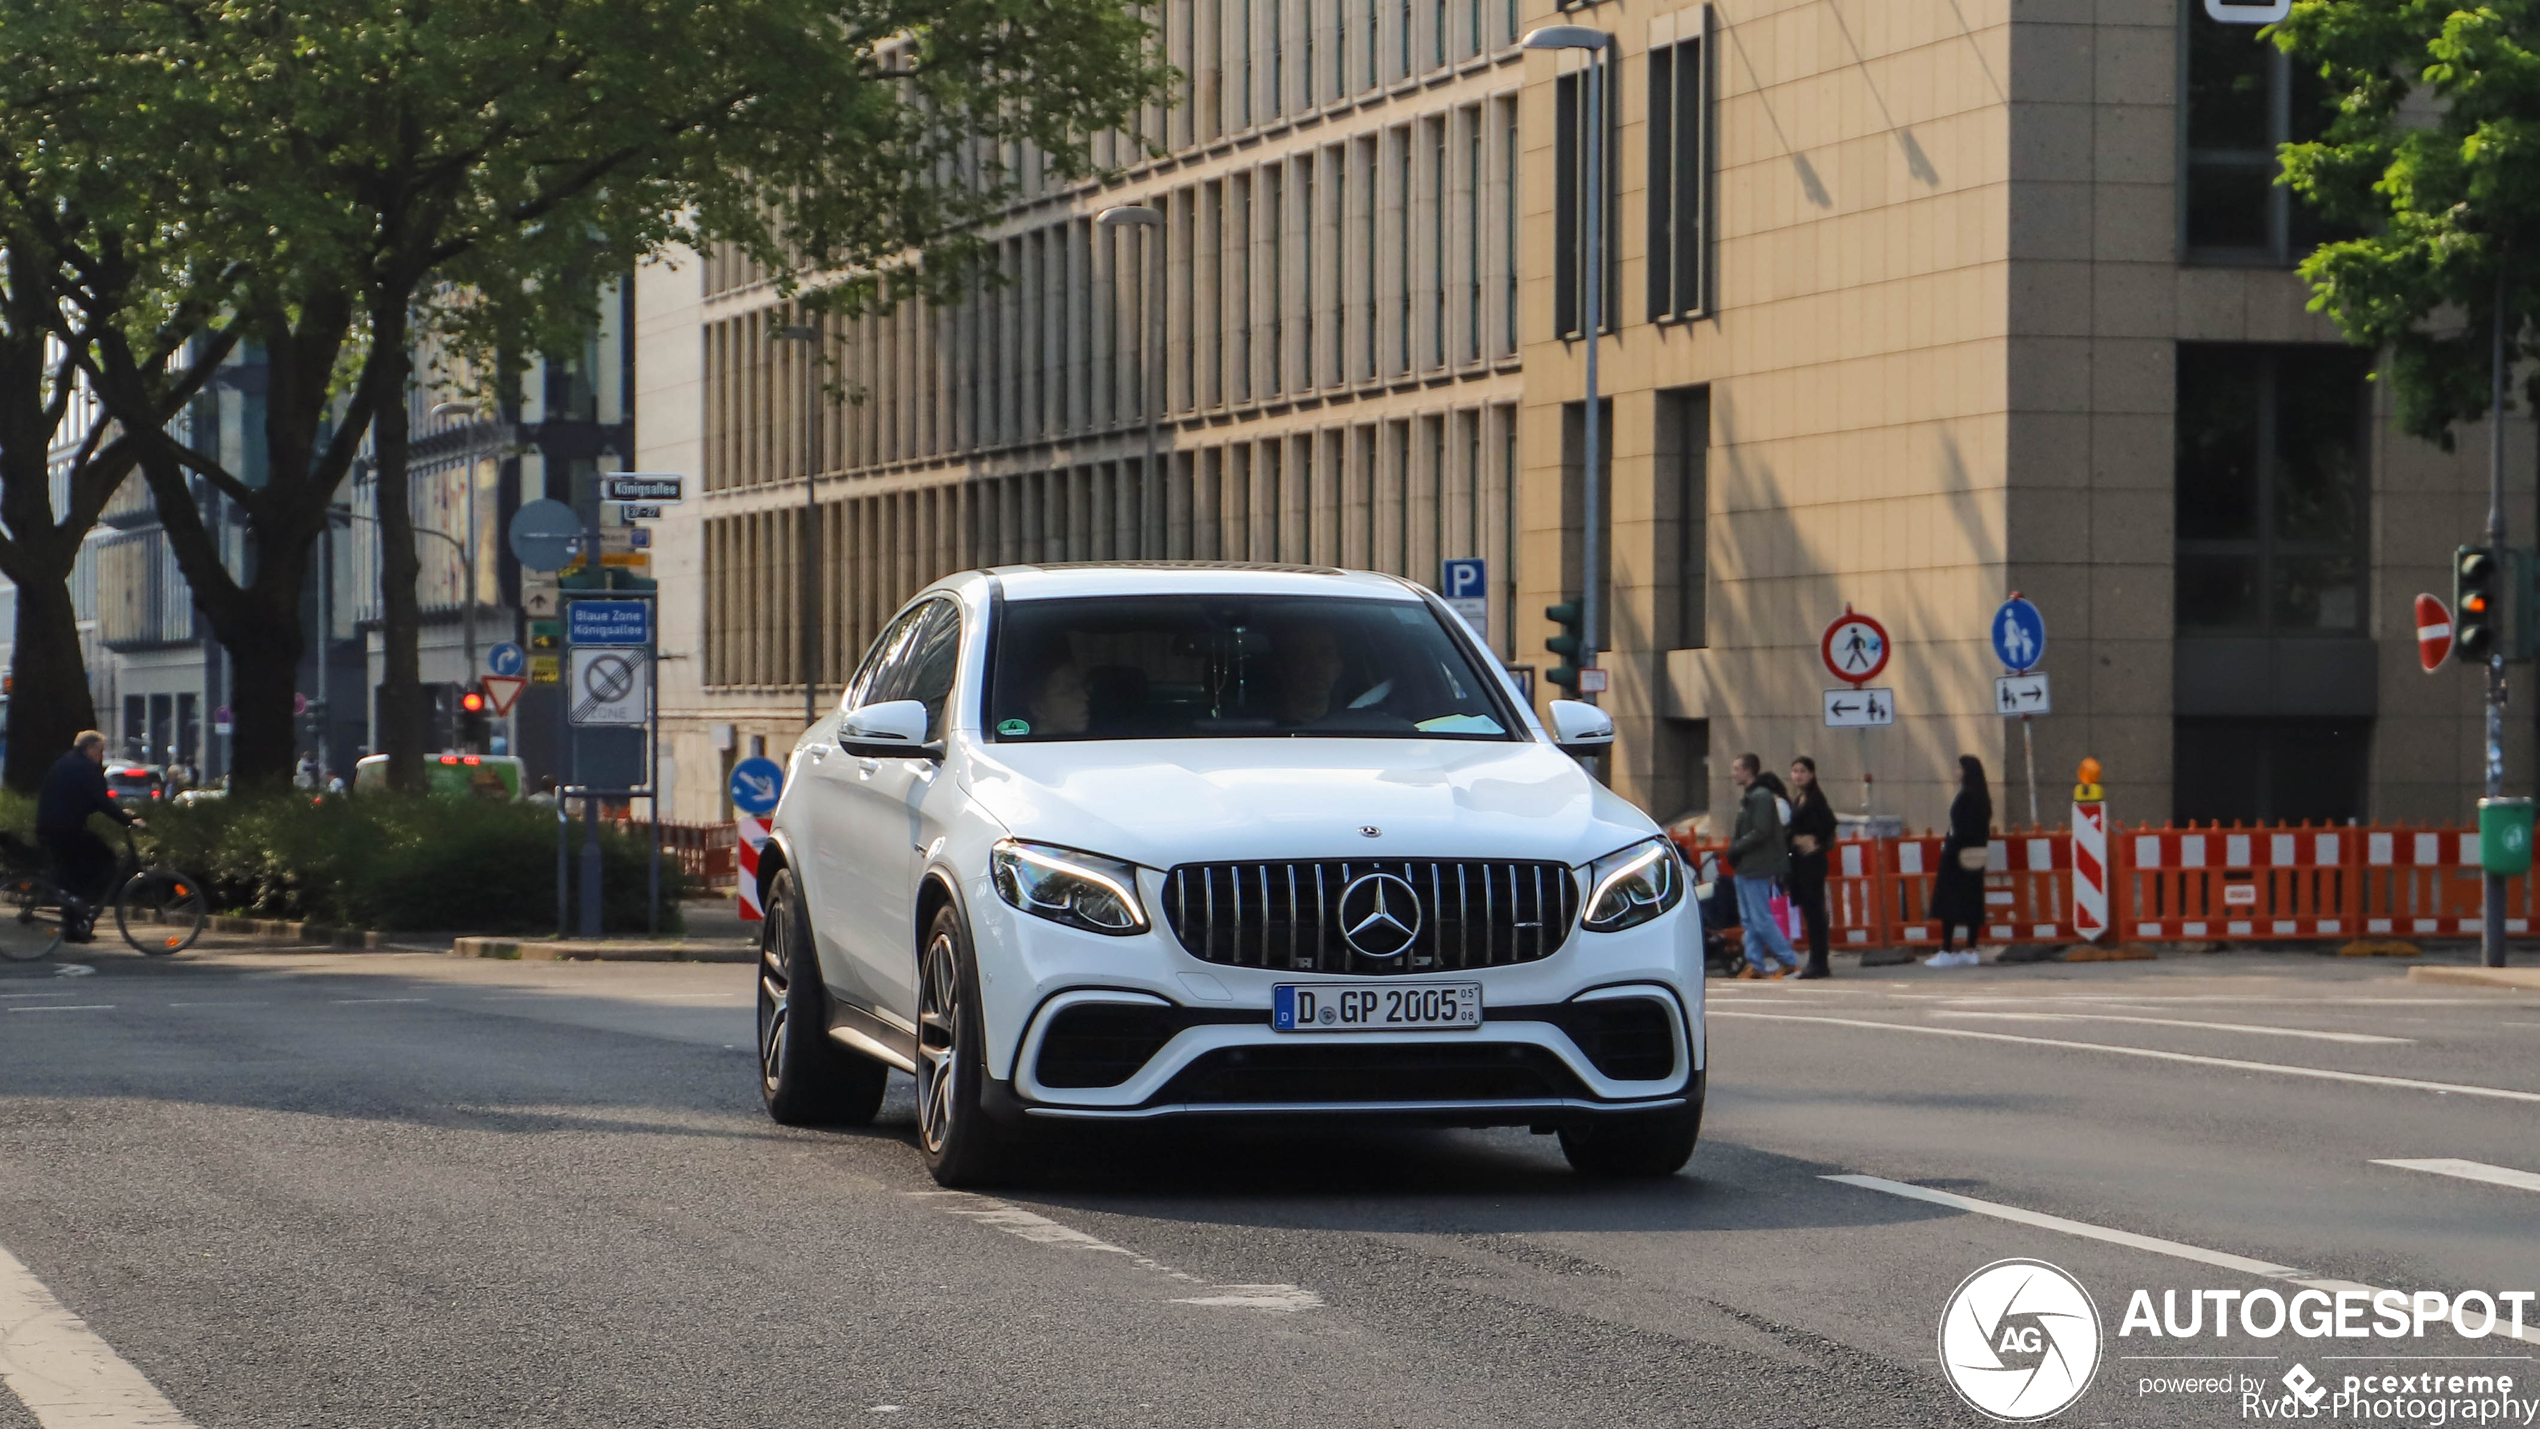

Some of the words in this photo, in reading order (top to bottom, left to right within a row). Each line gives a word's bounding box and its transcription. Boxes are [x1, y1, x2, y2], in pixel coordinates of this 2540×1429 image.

[614, 481, 678, 497] Königsallee
[1453, 564, 1477, 597] P
[575, 610, 608, 621] Blaue
[612, 610, 642, 621] Zone
[574, 625, 642, 637] Königsallee
[590, 707, 627, 719] ZONE
[1008, 721, 1018, 730] 4
[1461, 989, 1474, 998] 05
[1298, 992, 1315, 1023] D
[1340, 991, 1378, 1023] GP
[1386, 989, 1457, 1022] 2005
[1281, 1012, 1289, 1022] D
[1461, 1011, 1474, 1021] 08
